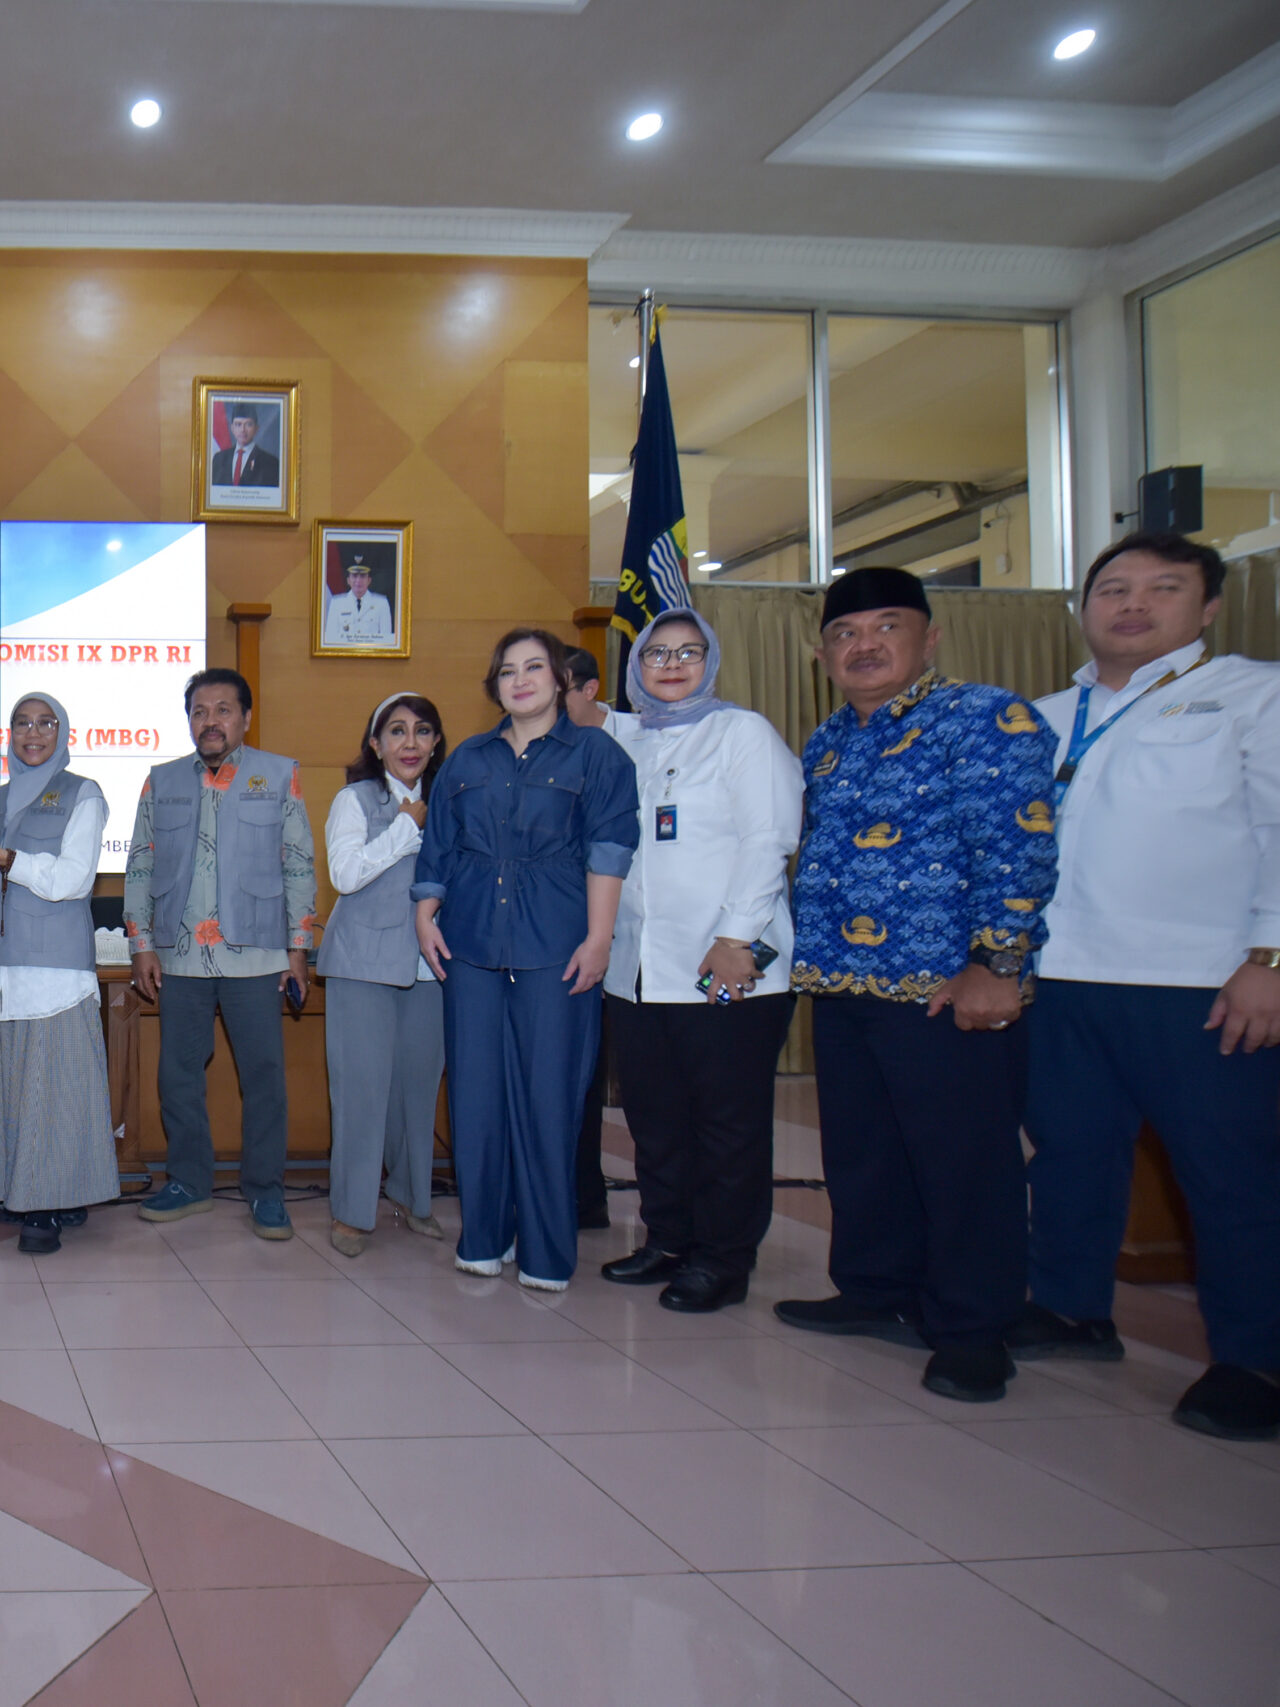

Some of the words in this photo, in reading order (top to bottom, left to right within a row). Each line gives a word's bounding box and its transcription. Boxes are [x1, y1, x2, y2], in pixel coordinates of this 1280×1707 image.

[77, 645, 102, 662] IX
[111, 645, 159, 662] DPR
[167, 646, 192, 662] RI
[86, 728, 160, 751] (MBG)
